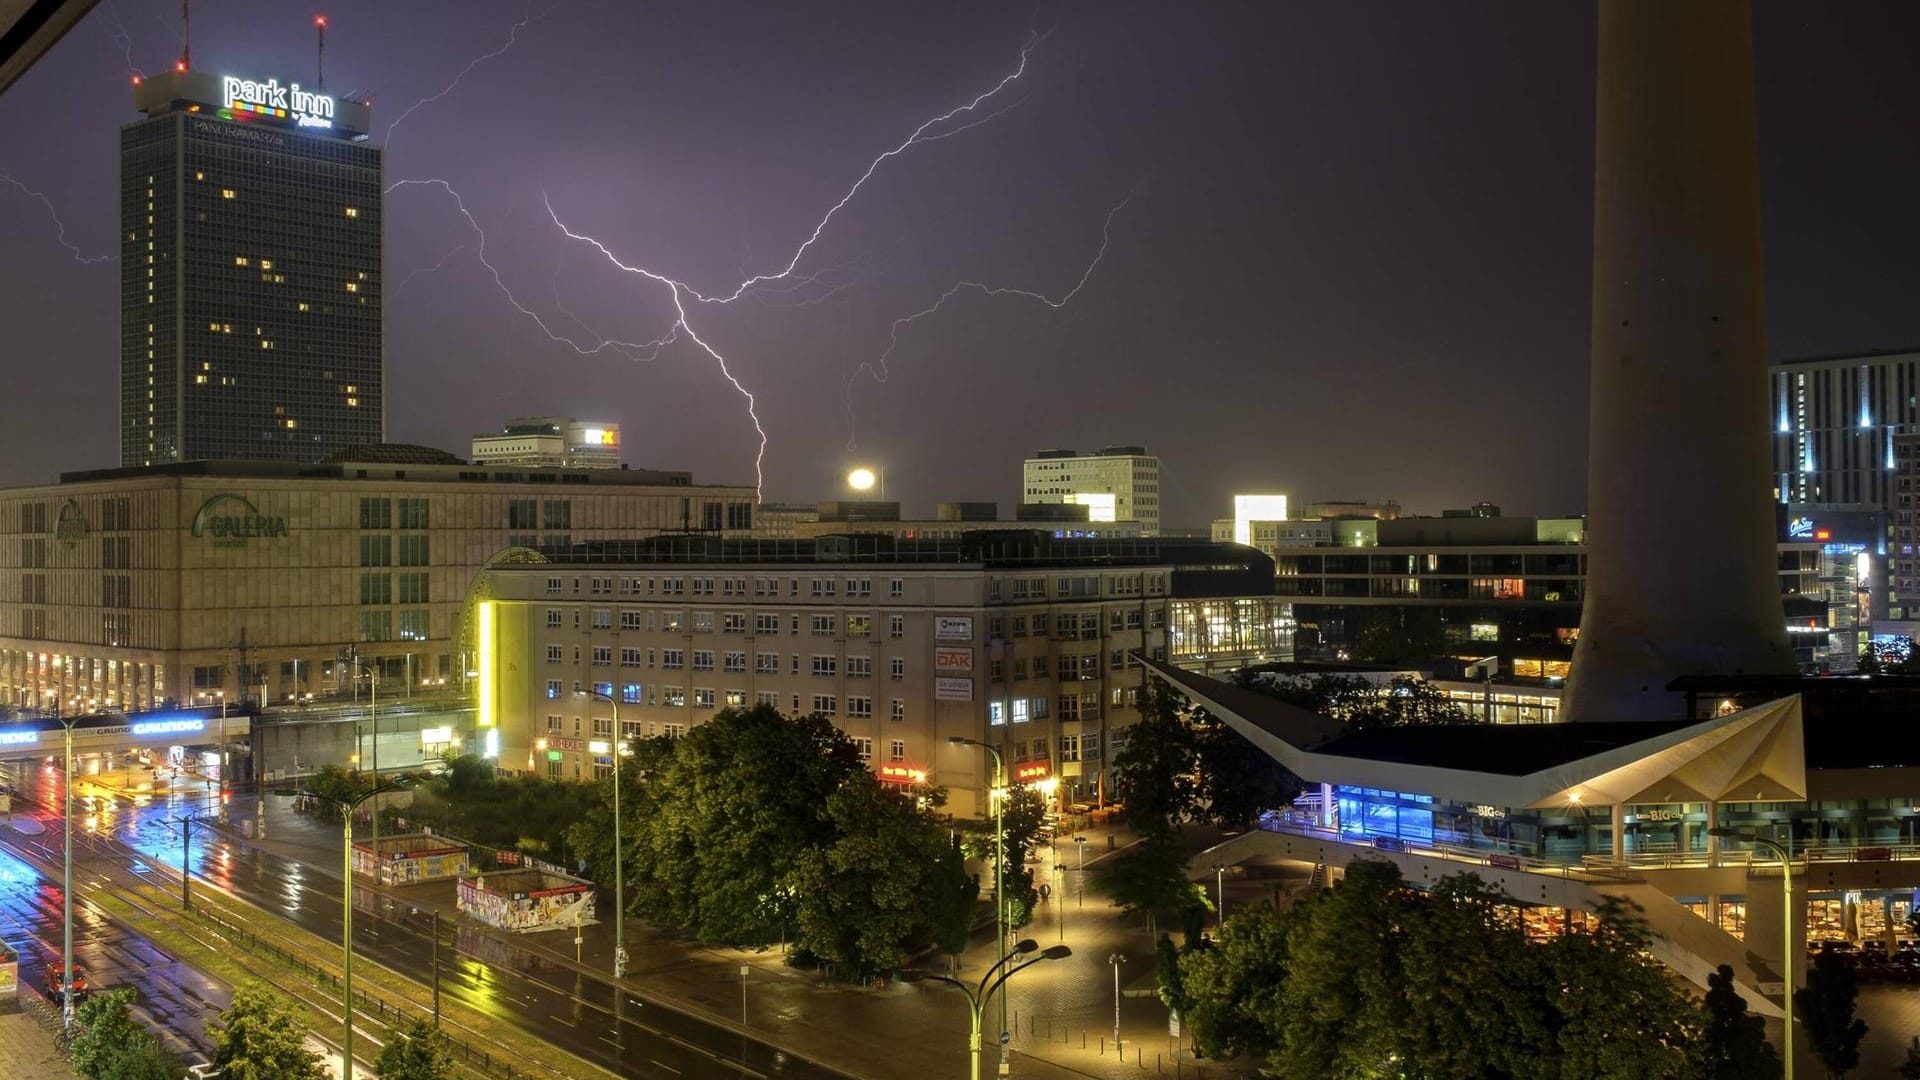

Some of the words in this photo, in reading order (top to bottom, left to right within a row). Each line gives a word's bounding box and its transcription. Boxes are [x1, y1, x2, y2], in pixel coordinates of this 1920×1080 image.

[224, 76, 288, 109] park
[291, 84, 334, 118] inn
[209, 514, 288, 538] GALERIA
[936, 653, 970, 667] DAK
[96, 727, 131, 736] GRUND
[133, 720, 205, 734] GRUNDIG
[1477, 805, 1495, 818] BIG
[1650, 810, 1671, 821] BIG
